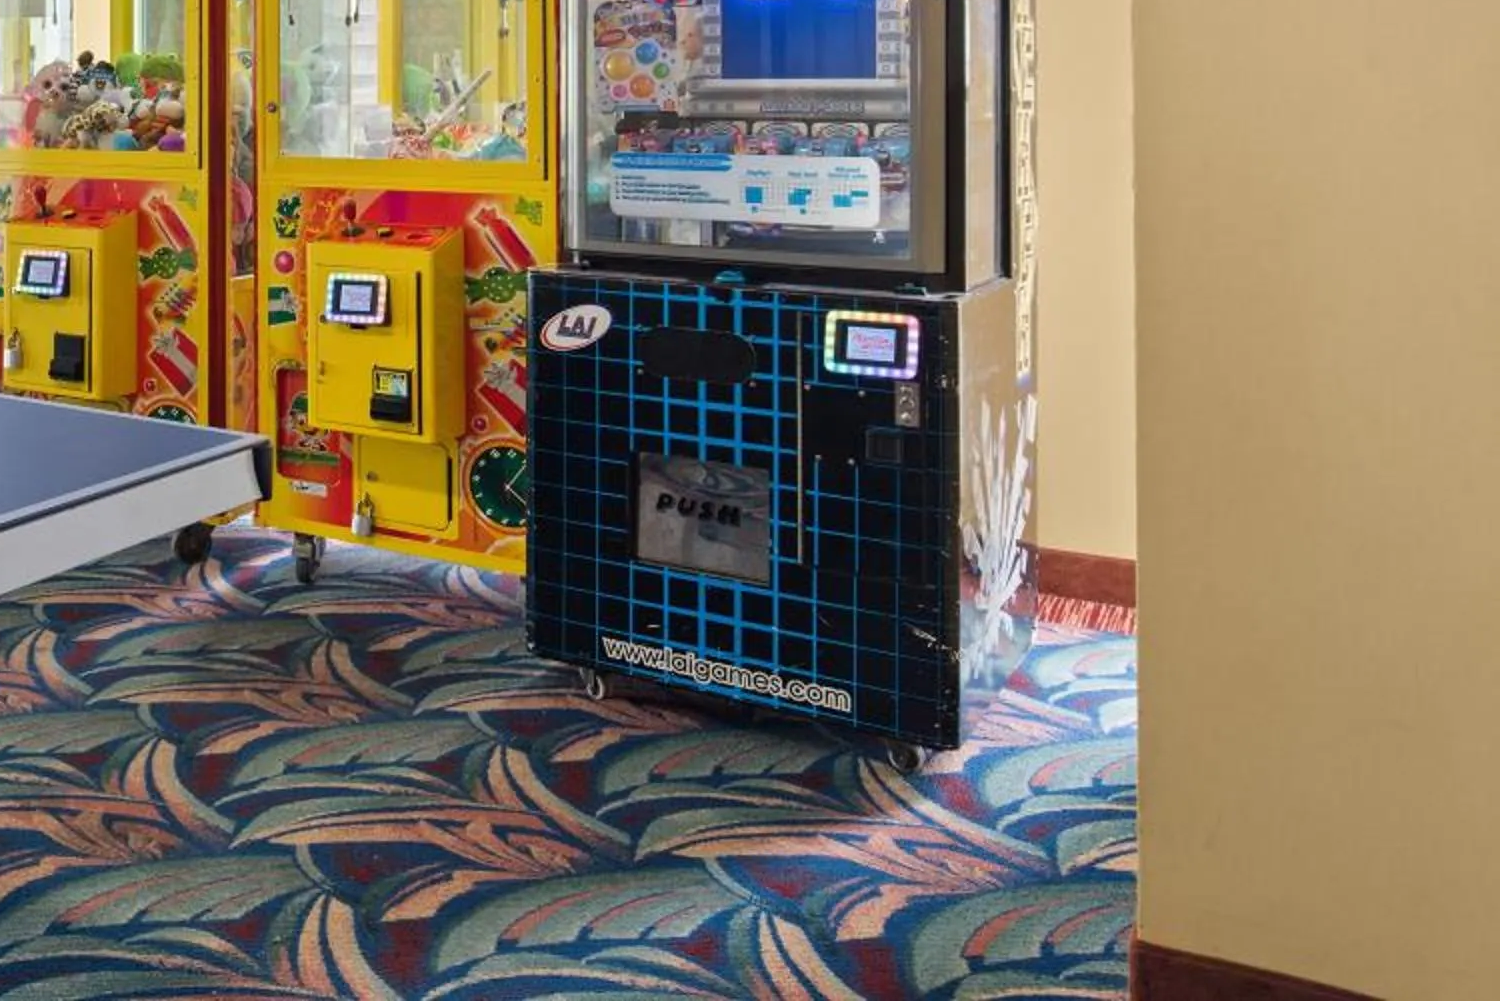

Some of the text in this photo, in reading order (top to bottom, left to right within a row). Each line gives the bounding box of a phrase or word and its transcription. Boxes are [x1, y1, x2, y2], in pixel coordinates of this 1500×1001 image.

[556, 312, 598, 340] LAI
[655, 492, 743, 528] PUSH
[601, 636, 853, 713] www.laigames.com
